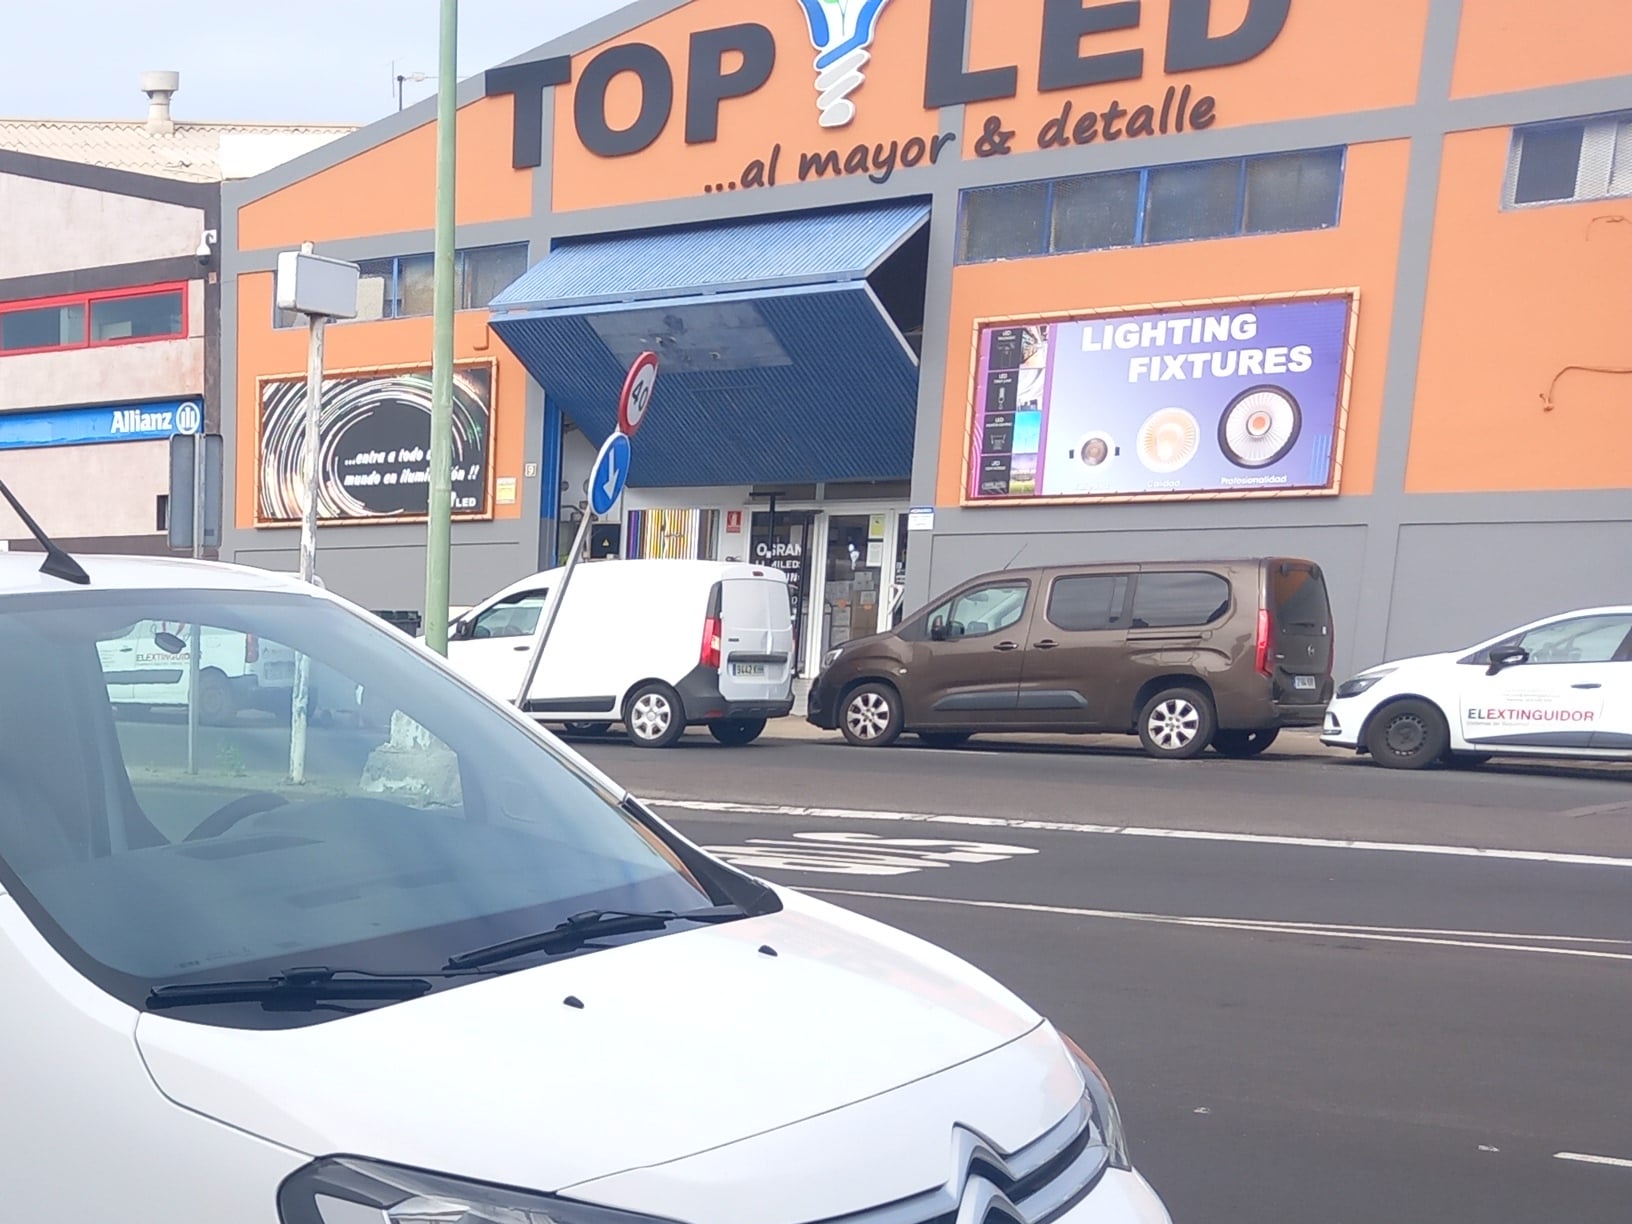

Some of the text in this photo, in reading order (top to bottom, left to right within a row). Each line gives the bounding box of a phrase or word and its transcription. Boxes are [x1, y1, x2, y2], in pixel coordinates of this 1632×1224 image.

[484, 0, 1292, 170] TOP LED
[797, 131, 956, 185] mayor
[973, 115, 1017, 157] &
[1037, 84, 1217, 149] detalle
[1081, 313, 1257, 352] LIGHTING
[1128, 345, 1312, 383] FIXTURES
[632, 380, 649, 412] 40
[110, 409, 173, 434] Allianz
[387, 451, 396, 463] a
[398, 446, 424, 463] todo
[344, 470, 382, 486] mundo
[383, 473, 398, 485] en
